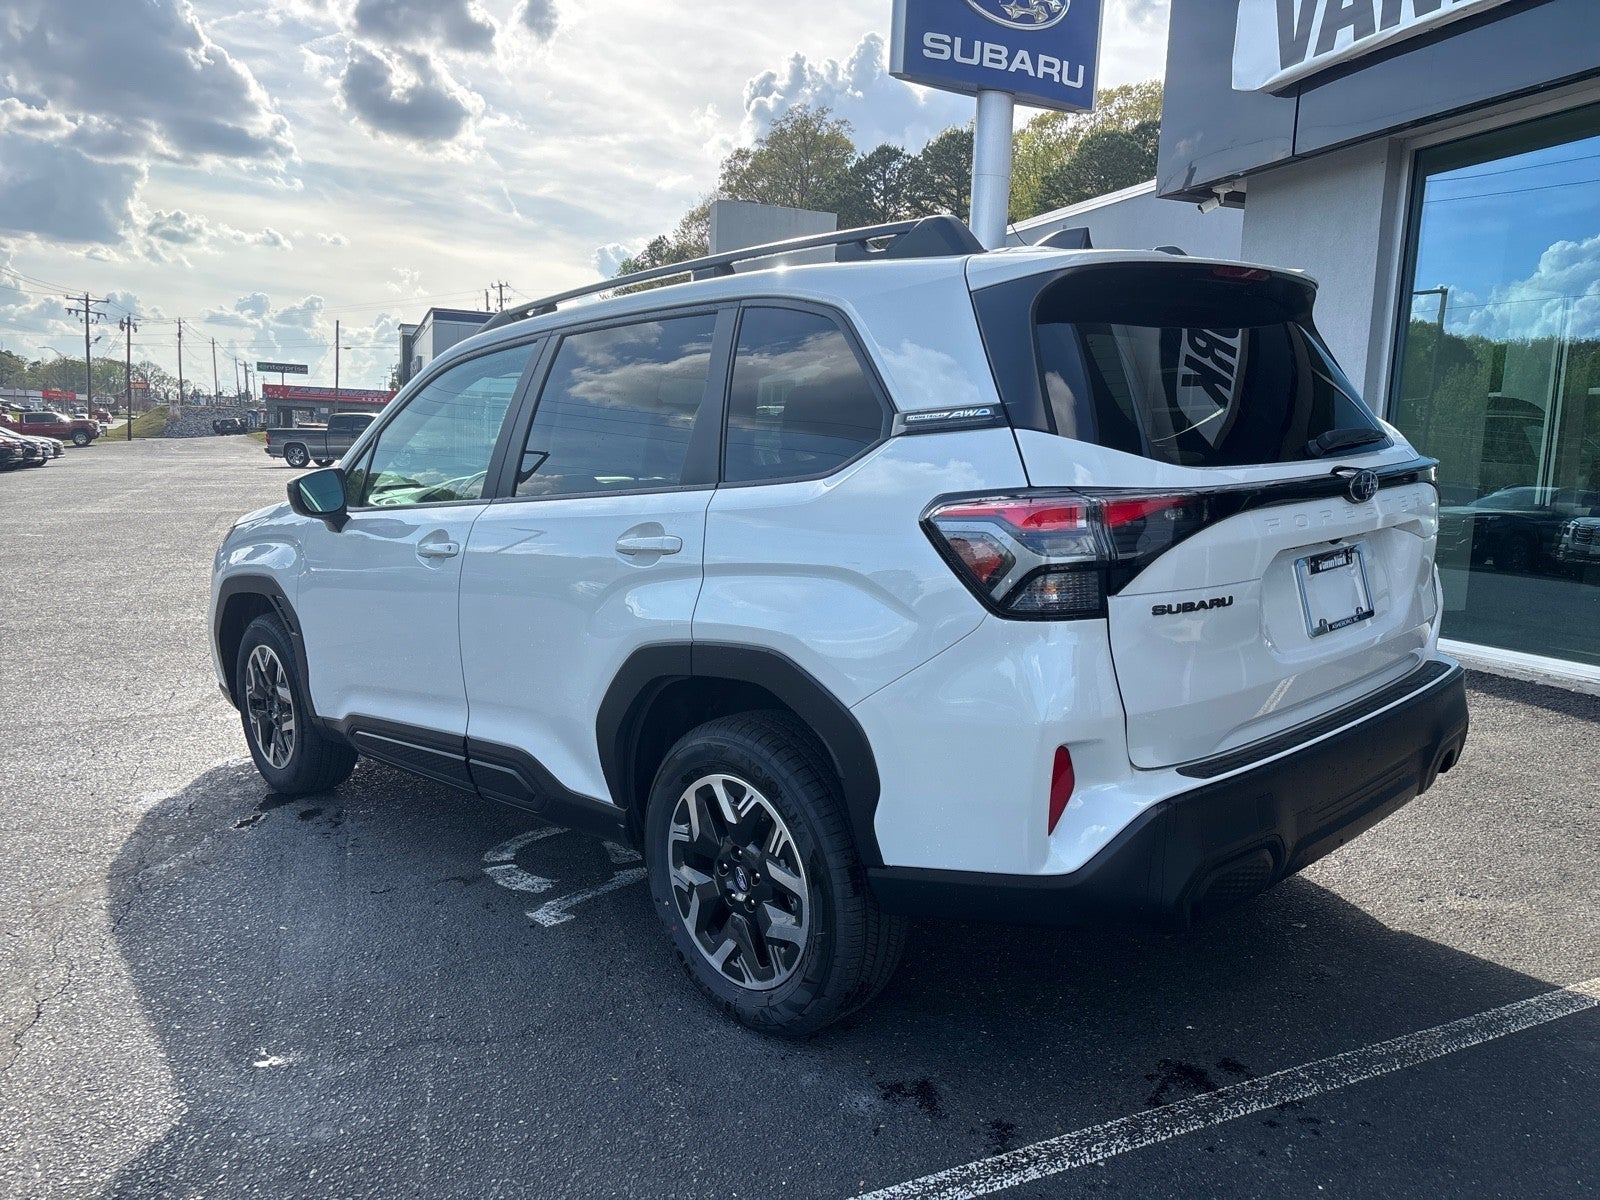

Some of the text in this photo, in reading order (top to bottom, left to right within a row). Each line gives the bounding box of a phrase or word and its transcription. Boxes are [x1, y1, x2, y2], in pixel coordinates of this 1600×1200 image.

[1275, 0, 1443, 71] VA
[922, 31, 1085, 89] SUBARU
[948, 408, 991, 419] AWD
[1264, 491, 1422, 534] FORESTER
[1151, 595, 1234, 616] SUBARU
